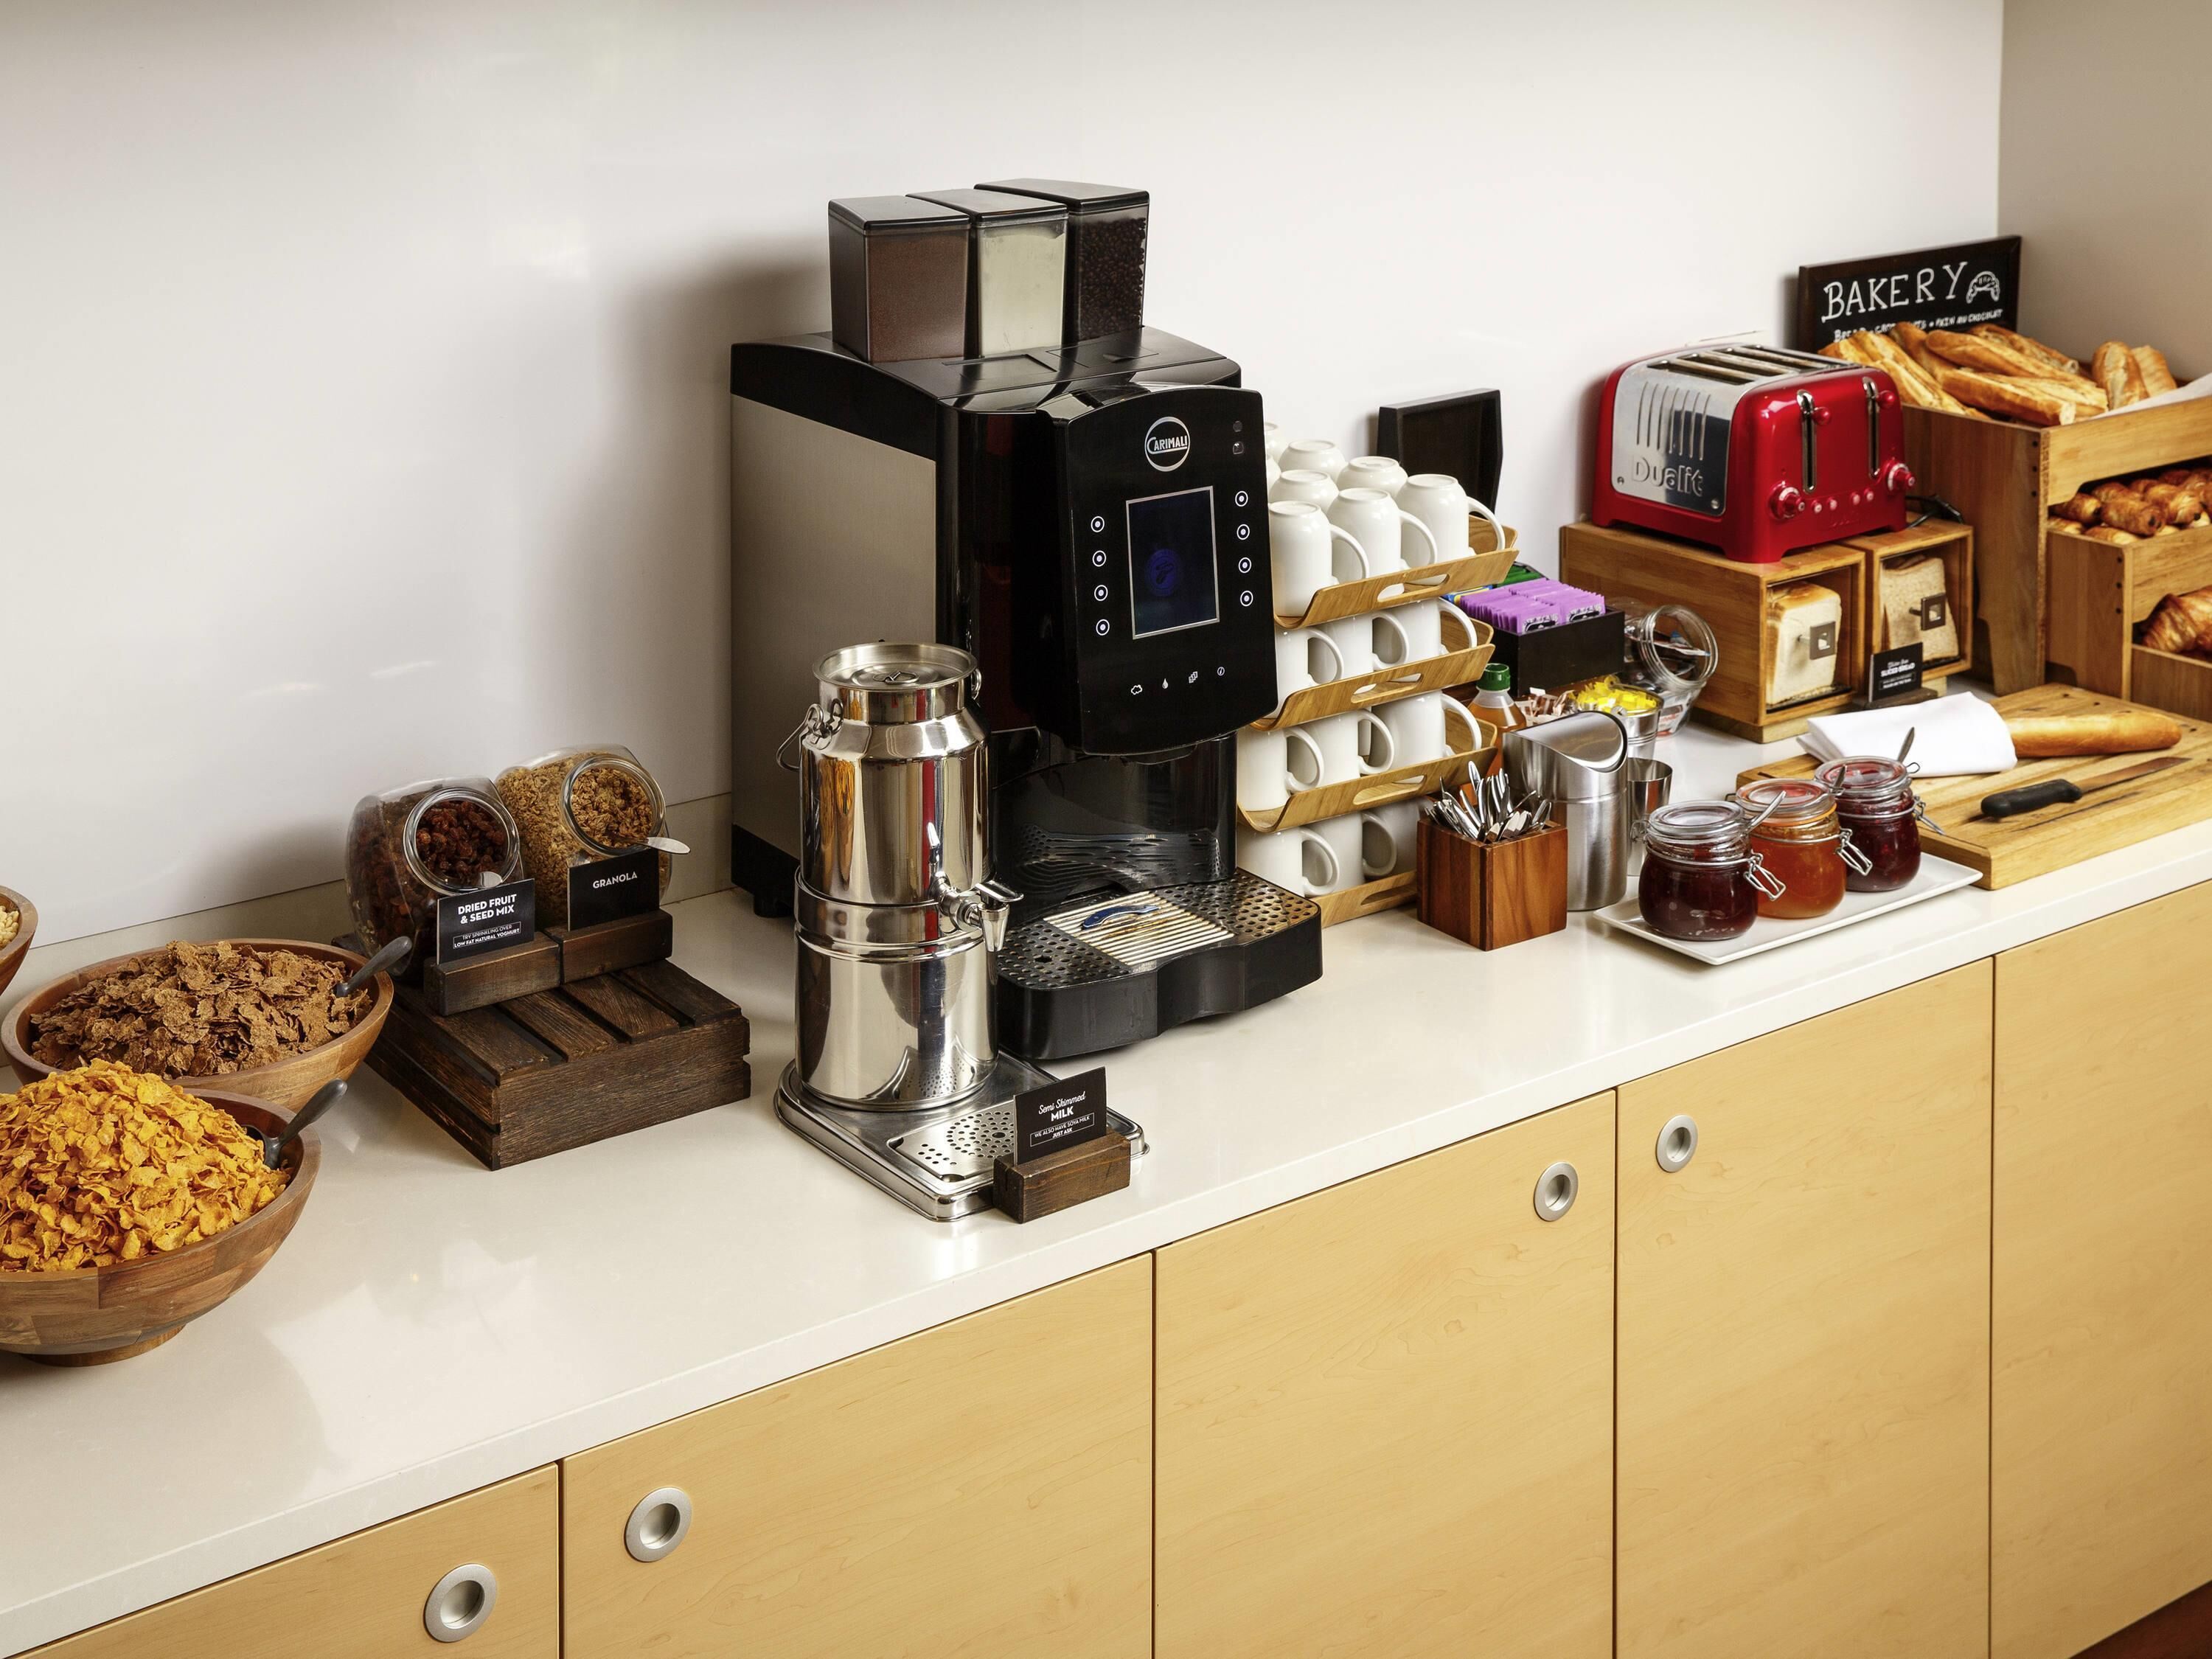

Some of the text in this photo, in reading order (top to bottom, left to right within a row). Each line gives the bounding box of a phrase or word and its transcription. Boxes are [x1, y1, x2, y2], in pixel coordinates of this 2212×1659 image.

[1821, 261, 1968, 323] BAKERY
[1147, 435, 1188, 455] CARIMALI
[1632, 456, 1703, 497] Dualit
[592, 871, 638, 889] GRANOLA
[458, 894, 517, 915] DRIED FRUIT
[460, 904, 515, 924] & SEED MIX
[472, 928, 498, 938] SPRINKLING
[475, 933, 496, 942] NATURAL
[497, 928, 520, 937] YOGHURT
[1038, 1091, 1086, 1115] Semi Skimmed
[1051, 1106, 1074, 1121] MILK
[1043, 1127, 1054, 1135] ALSO
[1054, 1123, 1067, 1132] HAVE
[1067, 1119, 1079, 1127] SOYA
[1079, 1115, 1090, 1123] MILK
[1052, 1130, 1063, 1138] JUST
